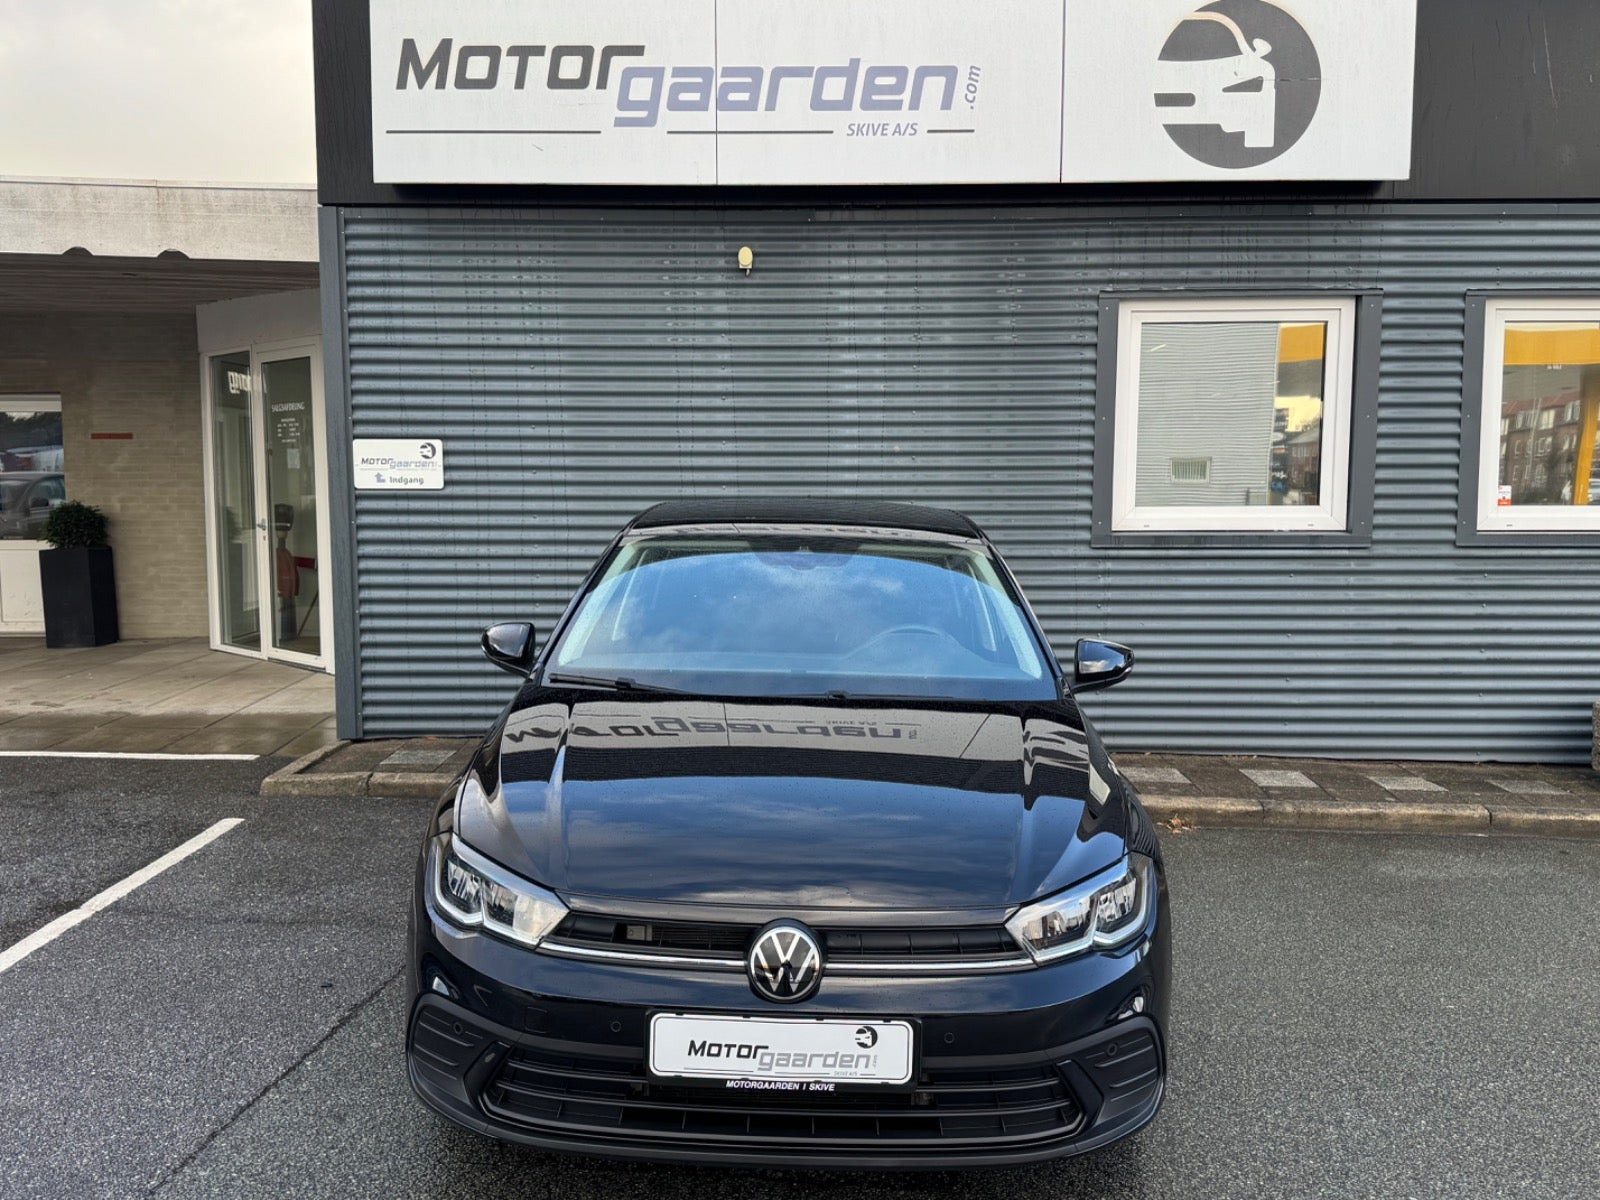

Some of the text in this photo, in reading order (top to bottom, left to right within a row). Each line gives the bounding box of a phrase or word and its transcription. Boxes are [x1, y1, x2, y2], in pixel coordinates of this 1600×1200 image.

[964, 65, 982, 110] .com
[846, 122, 919, 137] SKIVE A/S
[389, 475, 425, 486] Indgang
[725, 1080, 800, 1091] MOTORGAARDEN
[808, 1082, 836, 1092] SKIVE
